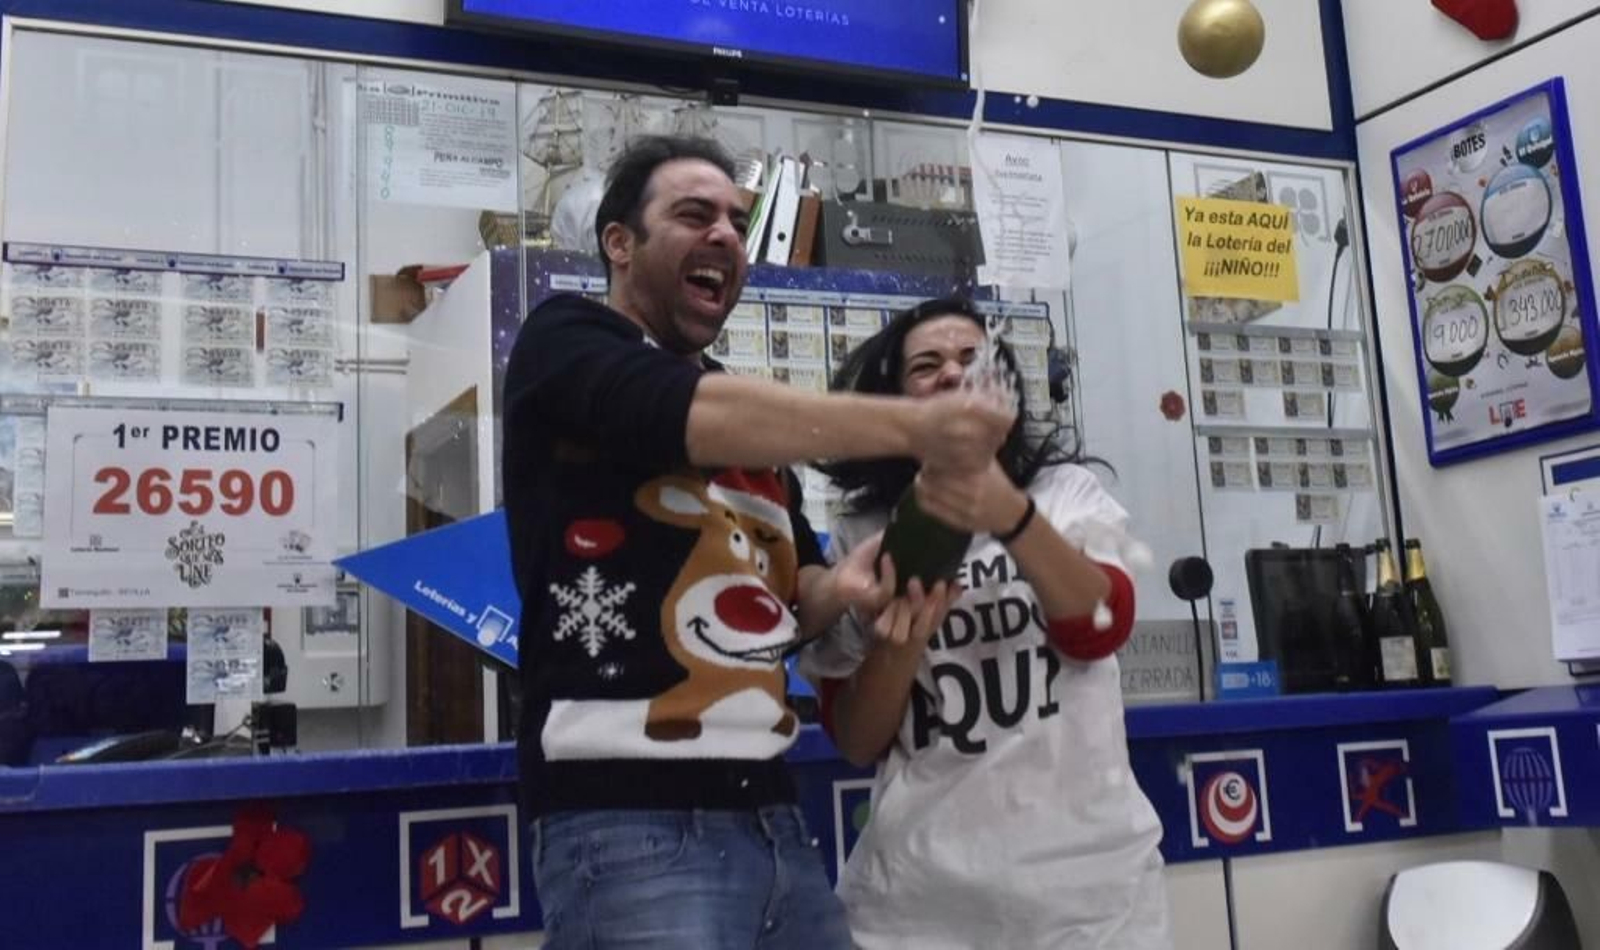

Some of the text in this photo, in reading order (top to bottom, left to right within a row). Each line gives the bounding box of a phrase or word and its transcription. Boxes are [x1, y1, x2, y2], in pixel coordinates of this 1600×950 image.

[1185, 206, 1205, 223] Ya
[1208, 210, 1243, 226] esta
[1187, 231, 1202, 248] la
[1266, 238, 1292, 254] del
[113, 422, 280, 452] 1er PREMIO
[93, 466, 295, 517] 26590
